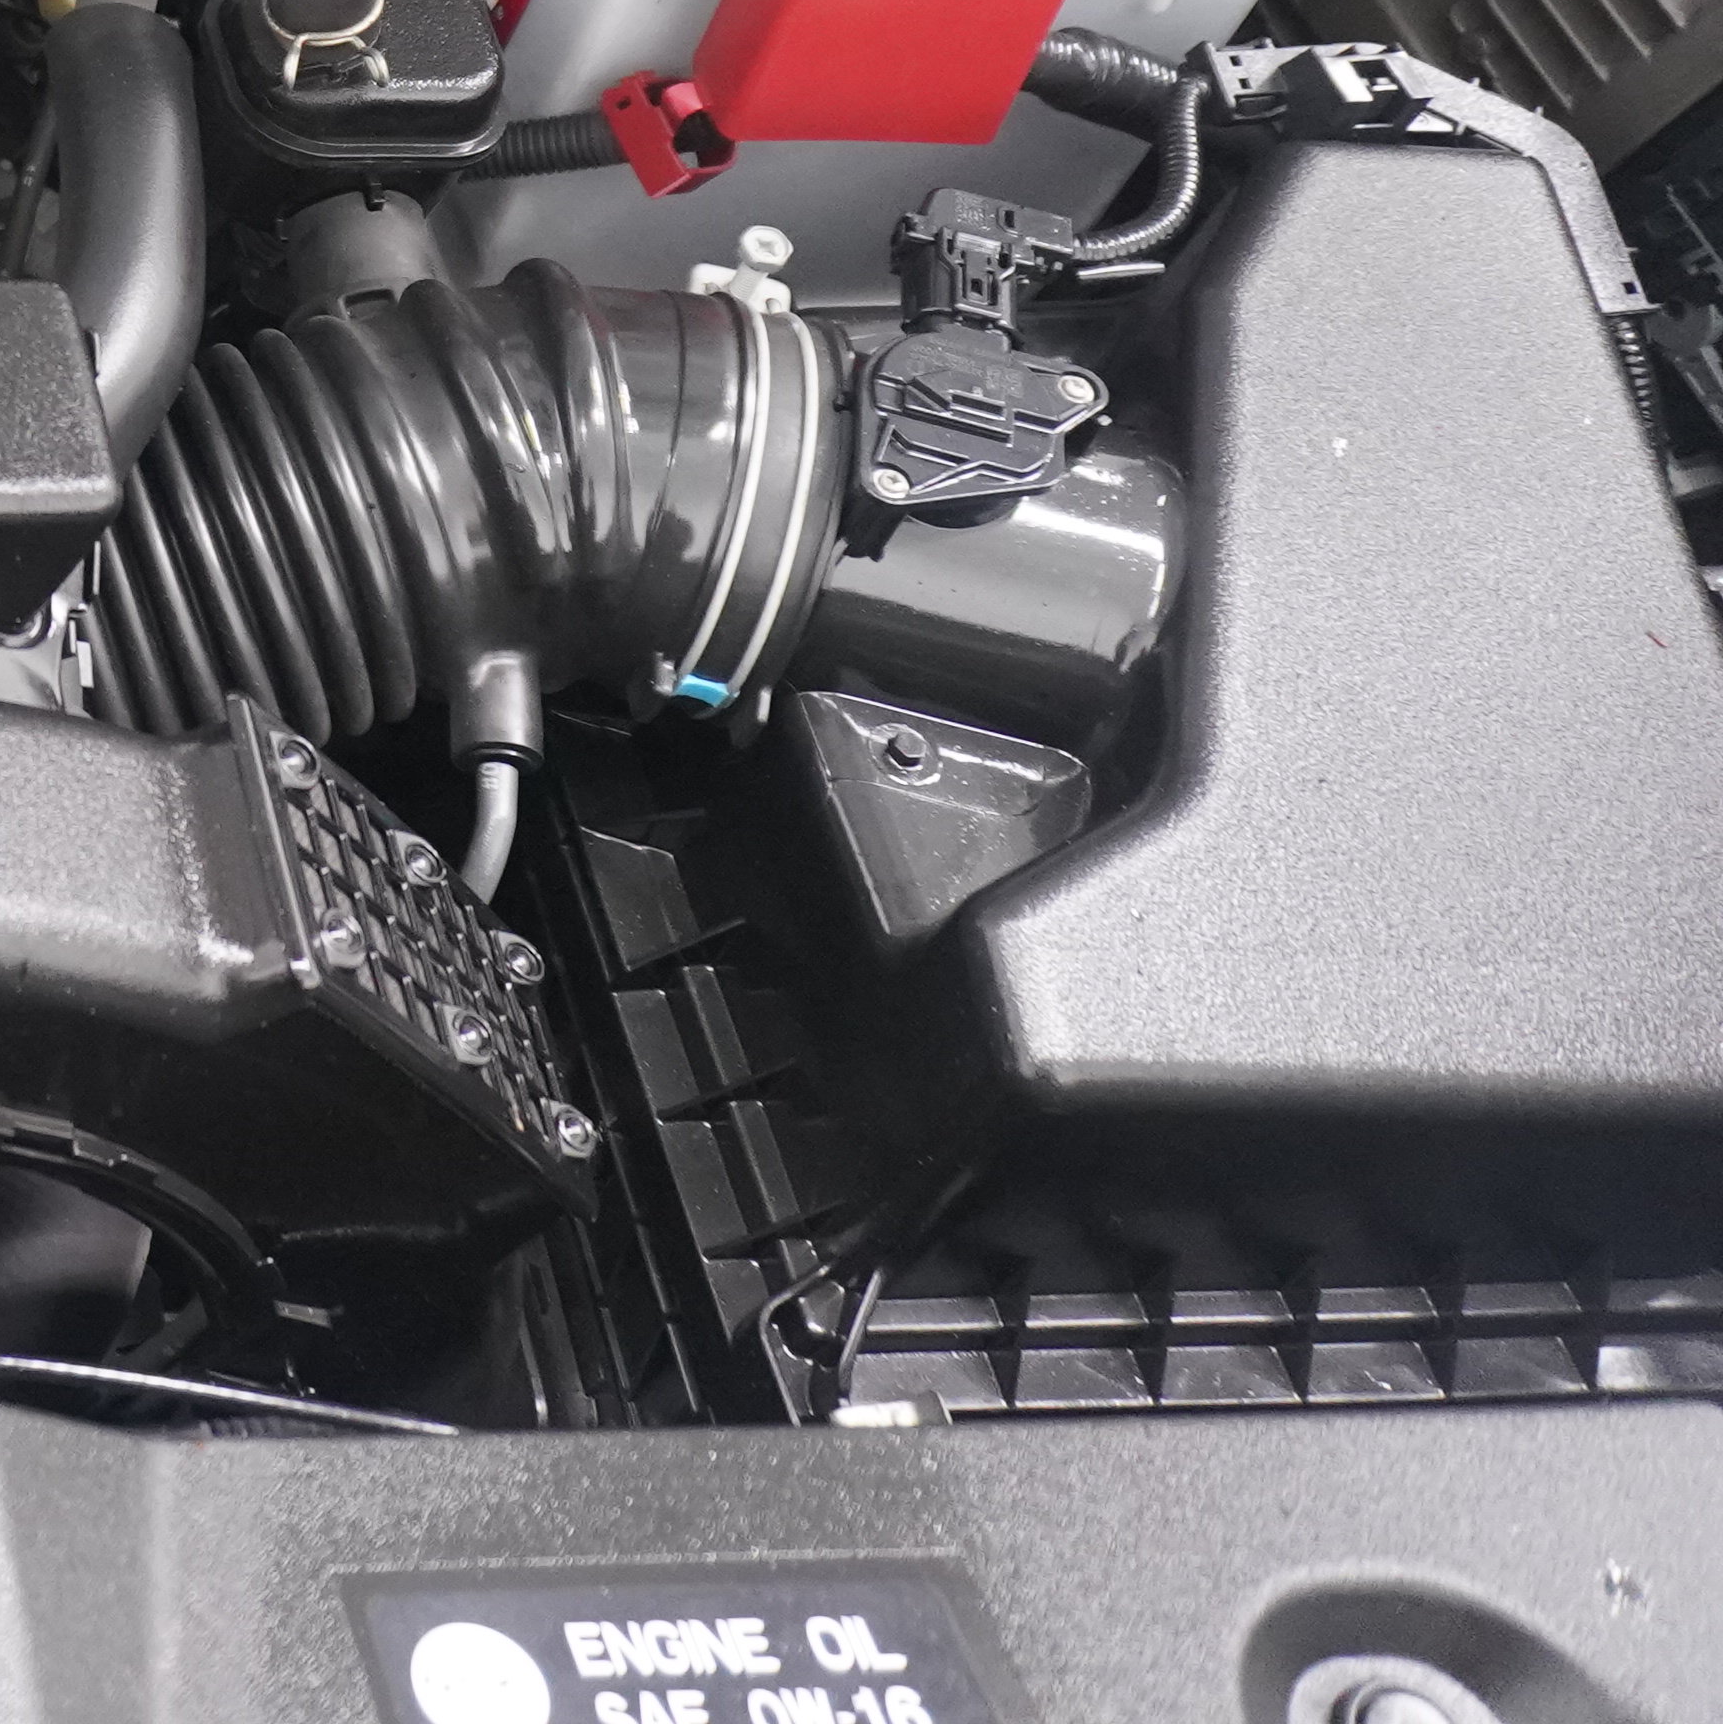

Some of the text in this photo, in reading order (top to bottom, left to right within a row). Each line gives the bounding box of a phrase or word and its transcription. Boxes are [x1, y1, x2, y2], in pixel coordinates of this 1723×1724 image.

[563, 1615, 908, 1678] ENGINE OIL
[594, 1689, 709, 1724] SAE
